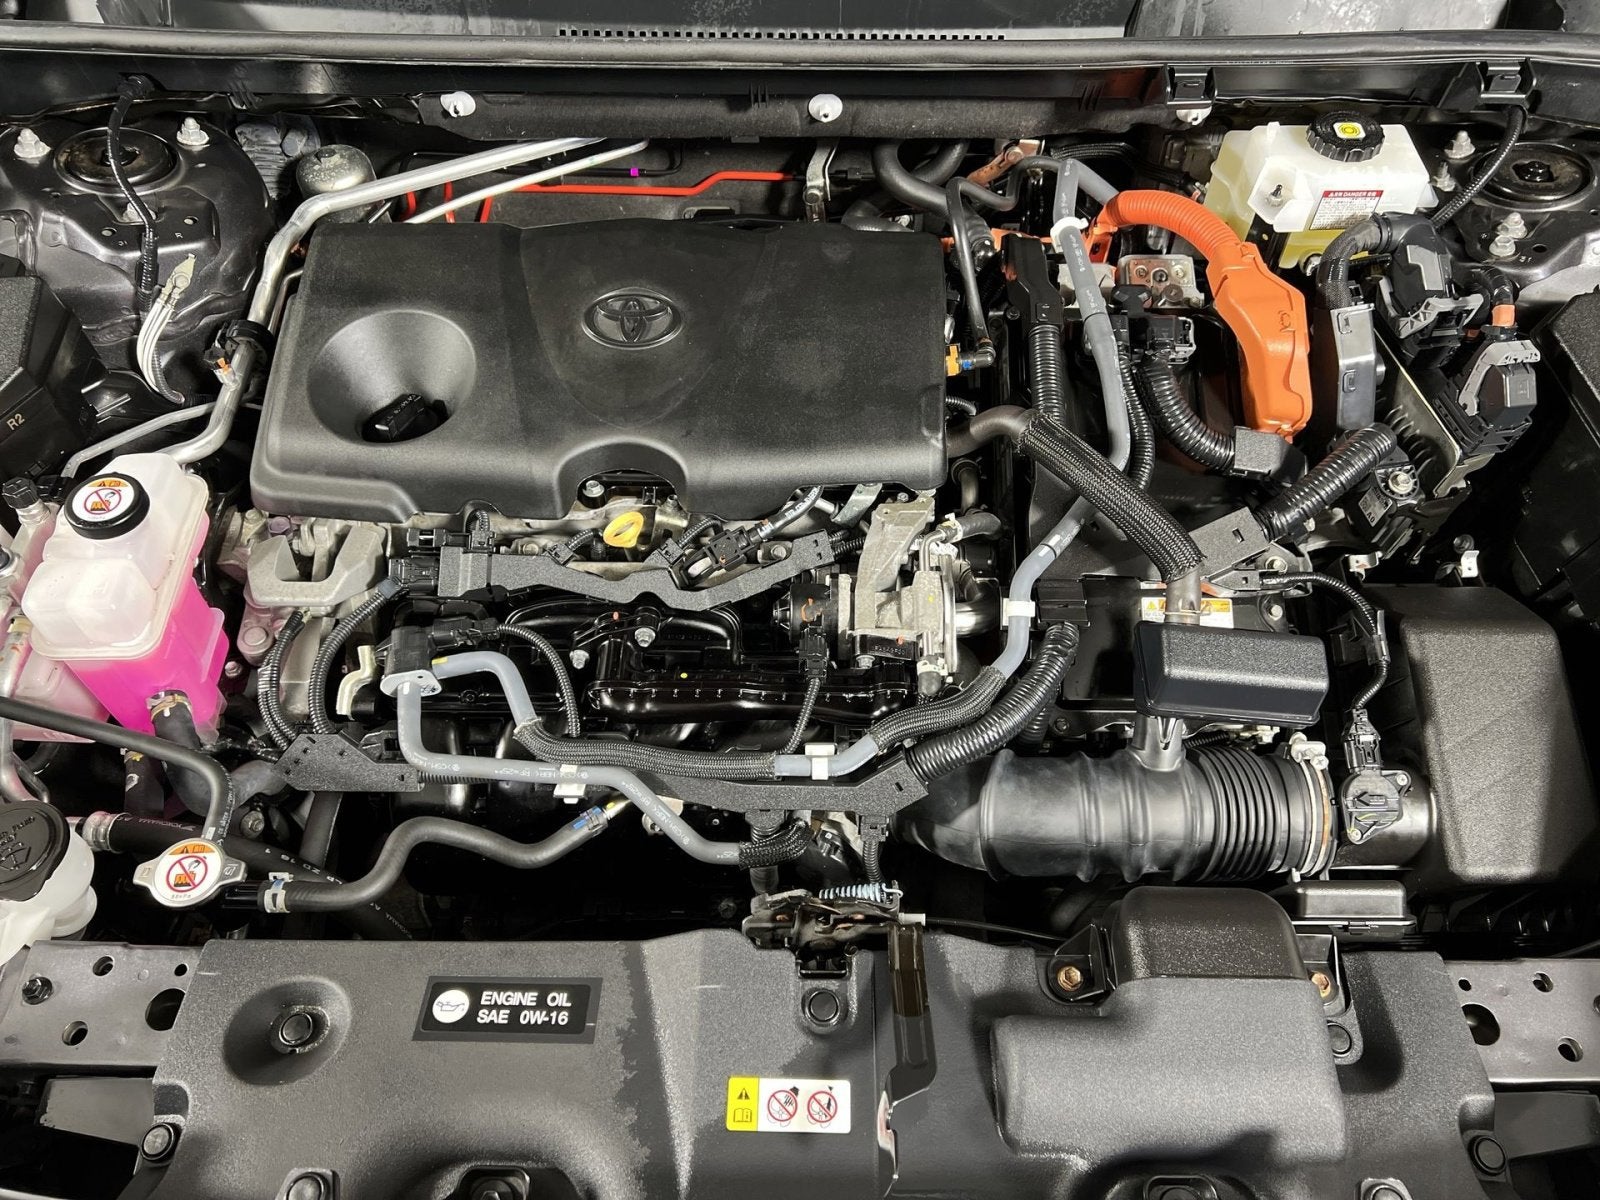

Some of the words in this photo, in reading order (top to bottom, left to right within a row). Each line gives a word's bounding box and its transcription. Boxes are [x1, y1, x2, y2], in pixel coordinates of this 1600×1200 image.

[6, 413, 25, 430] R2
[480, 991, 539, 1006] ENGINE
[546, 992, 572, 1007] OIL
[476, 1009, 510, 1024] SAE
[519, 1011, 569, 1026] 0W-16
